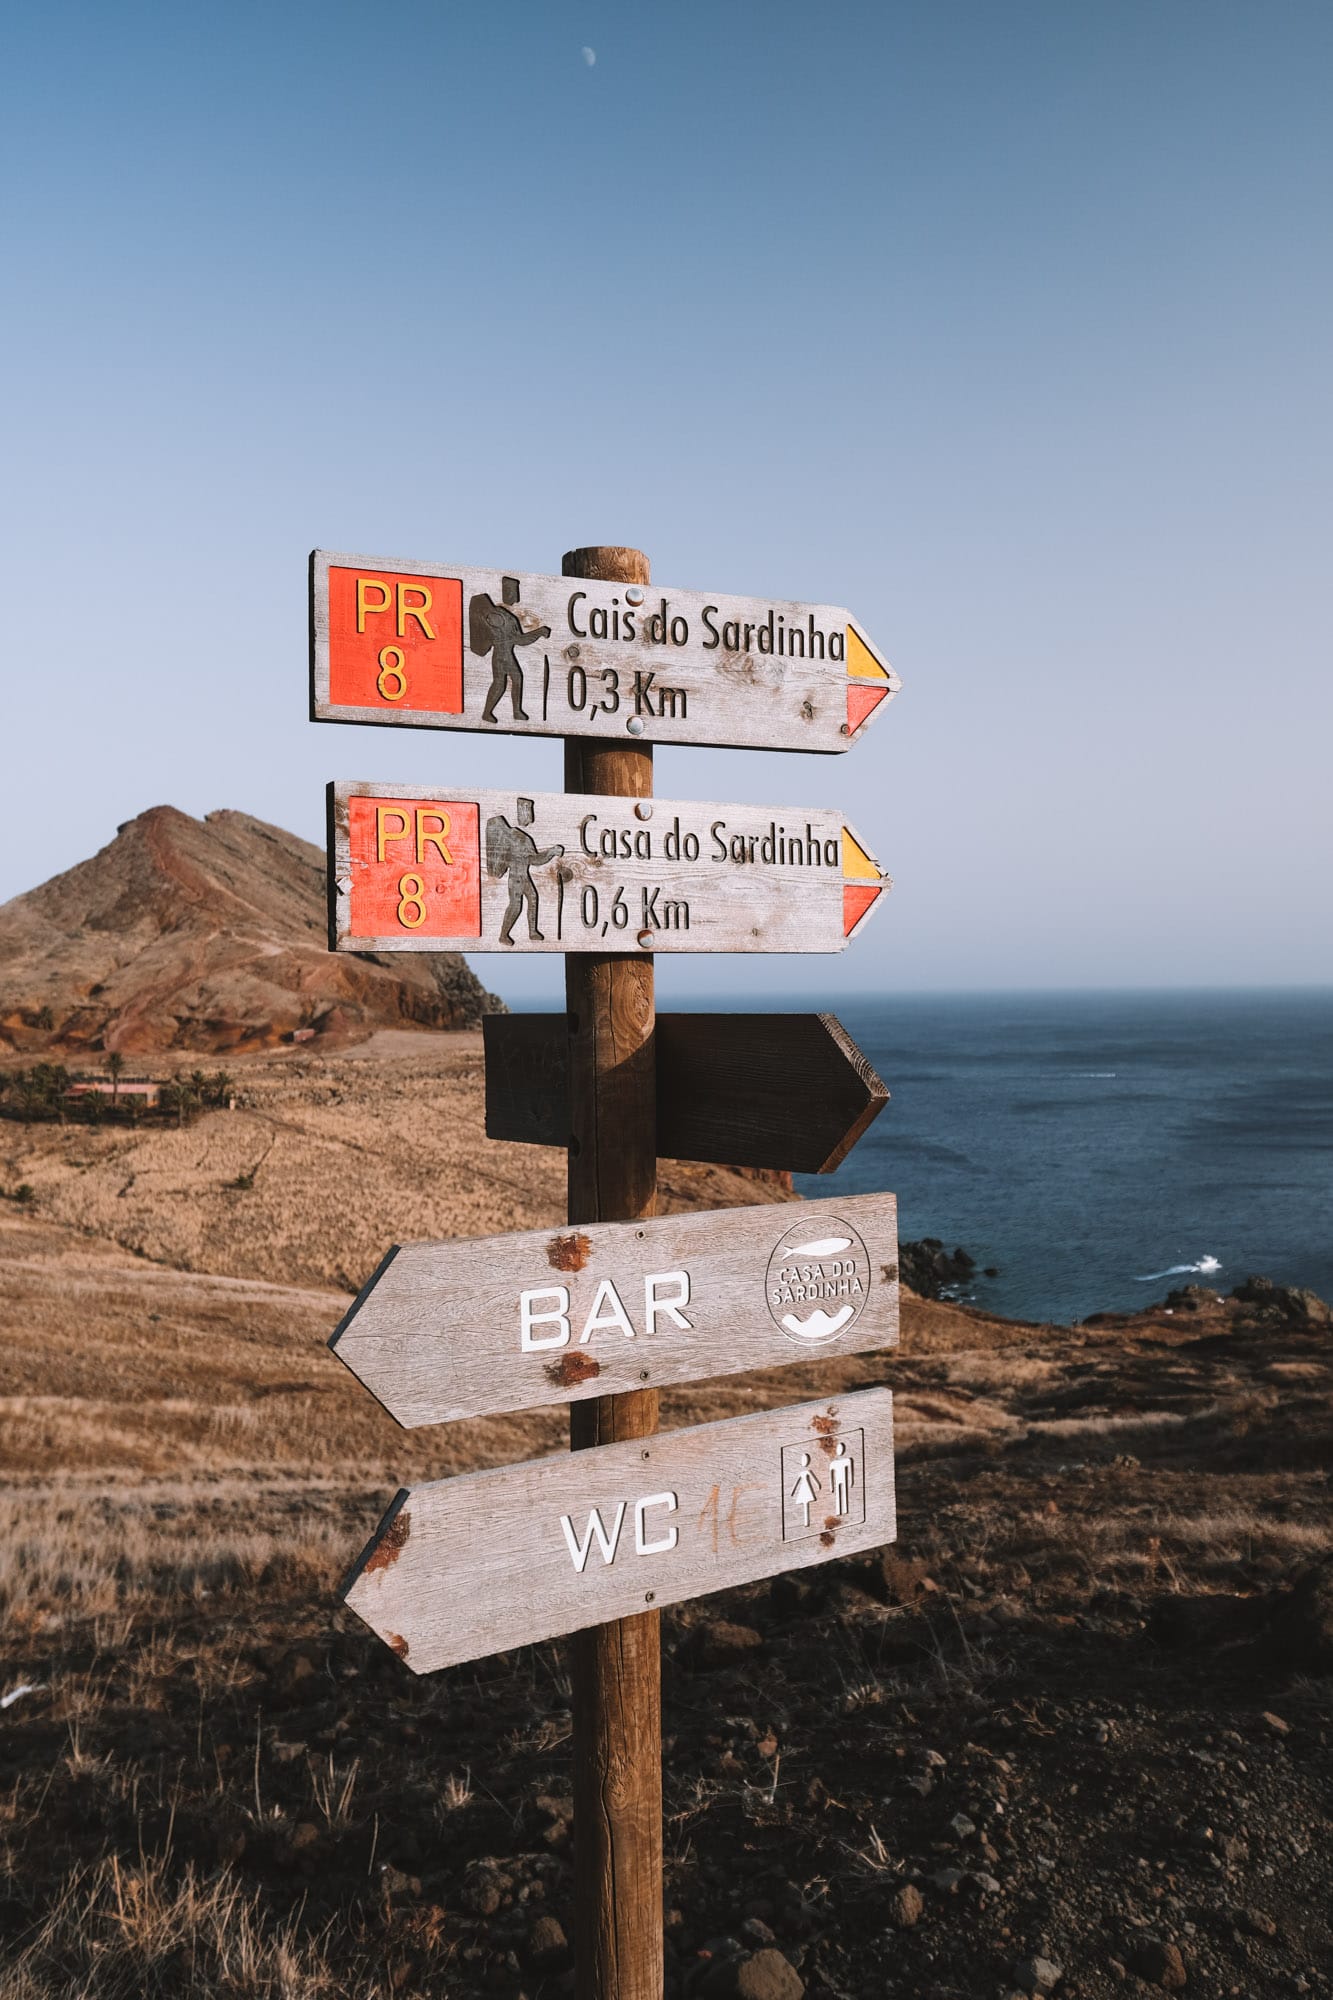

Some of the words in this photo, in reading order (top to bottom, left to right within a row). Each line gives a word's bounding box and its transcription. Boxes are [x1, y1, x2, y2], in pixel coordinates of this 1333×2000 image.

[356, 578, 435, 640] PR
[567, 591, 636, 642] Cais
[650, 599, 689, 646] do
[701, 605, 846, 661] Sardinha
[377, 645, 408, 701] 8
[567, 665, 620, 720] 0,3
[634, 670, 688, 719] Km
[376, 807, 454, 865] PR
[580, 814, 651, 861] Casa
[663, 816, 699, 862] do
[711, 821, 840, 867] Sardinha
[398, 873, 427, 929] 8
[580, 884, 629, 937] 0,6
[642, 886, 690, 930] Km
[773, 1277, 864, 1304] SARDINHA
[780, 1264, 826, 1284] CASA
[832, 1260, 856, 1277] DO
[520, 1270, 694, 1352] BAR
[560, 1491, 679, 1573] WC
